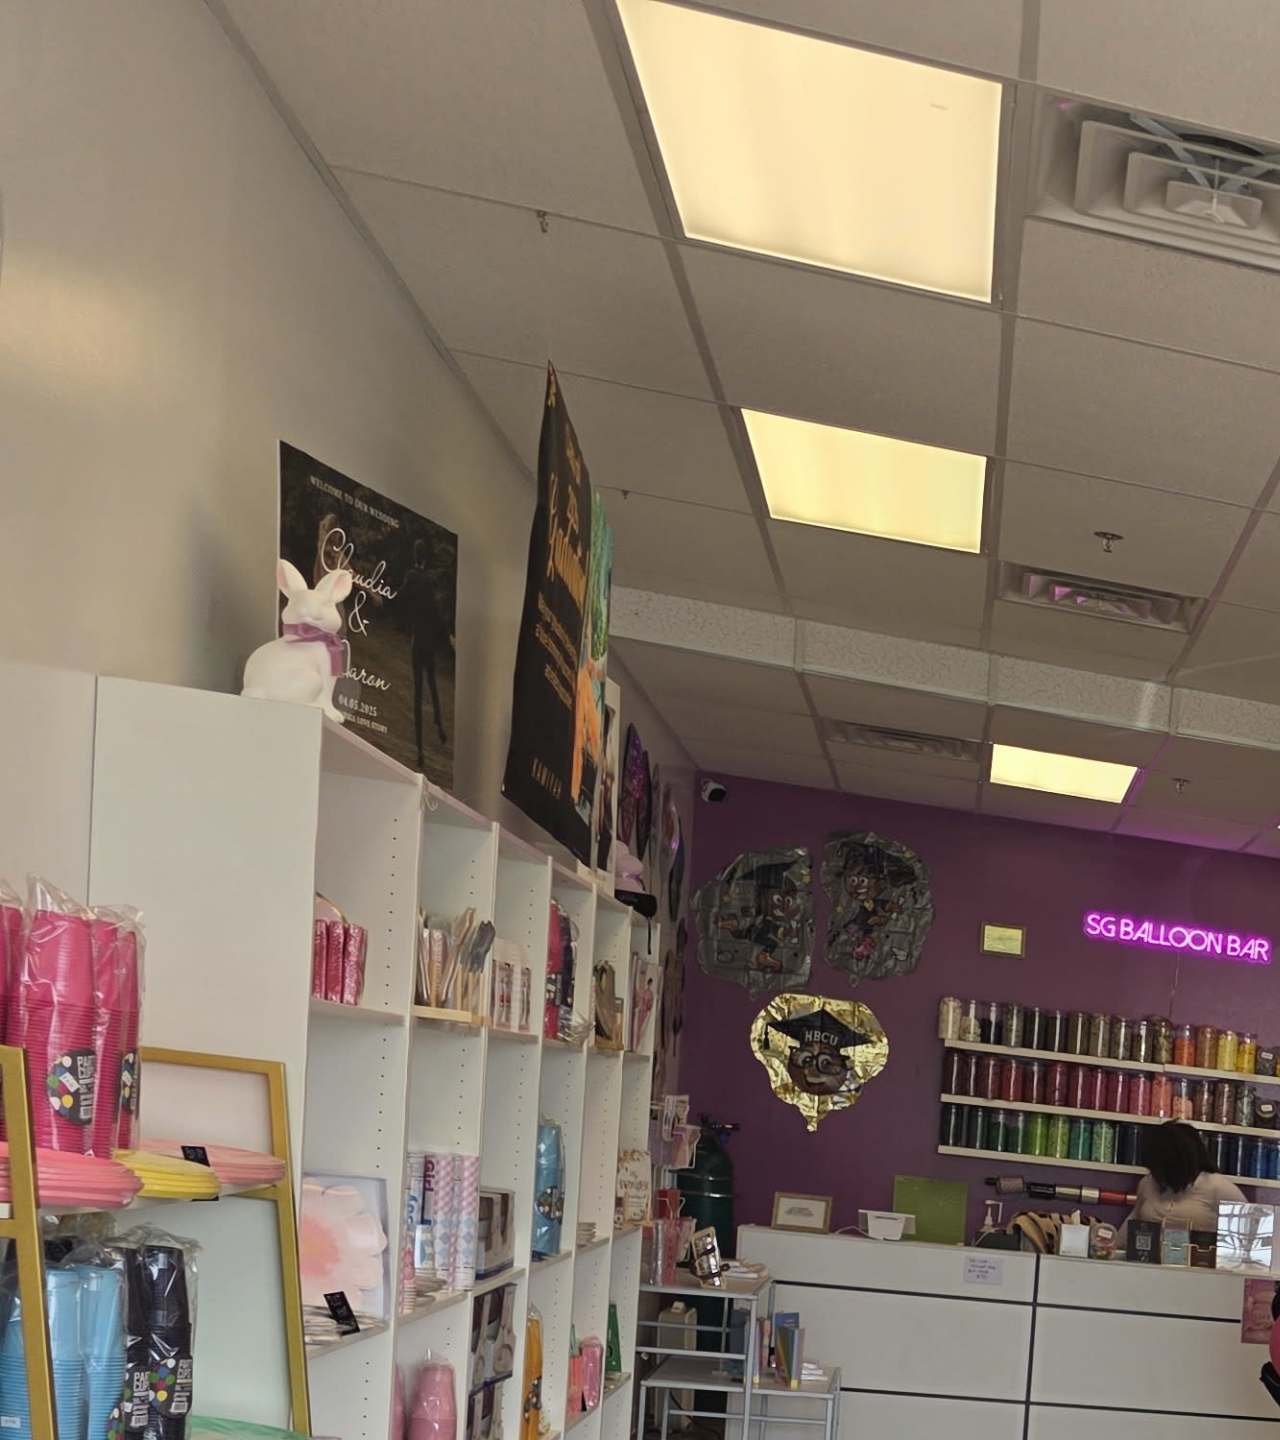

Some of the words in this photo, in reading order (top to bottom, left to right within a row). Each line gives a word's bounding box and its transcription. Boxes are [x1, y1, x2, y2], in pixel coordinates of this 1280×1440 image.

[1086, 914, 1116, 937] SG
[1119, 918, 1222, 953] BALLOON
[1226, 935, 1269, 960] BAR
[805, 1030, 838, 1046] HBCU
